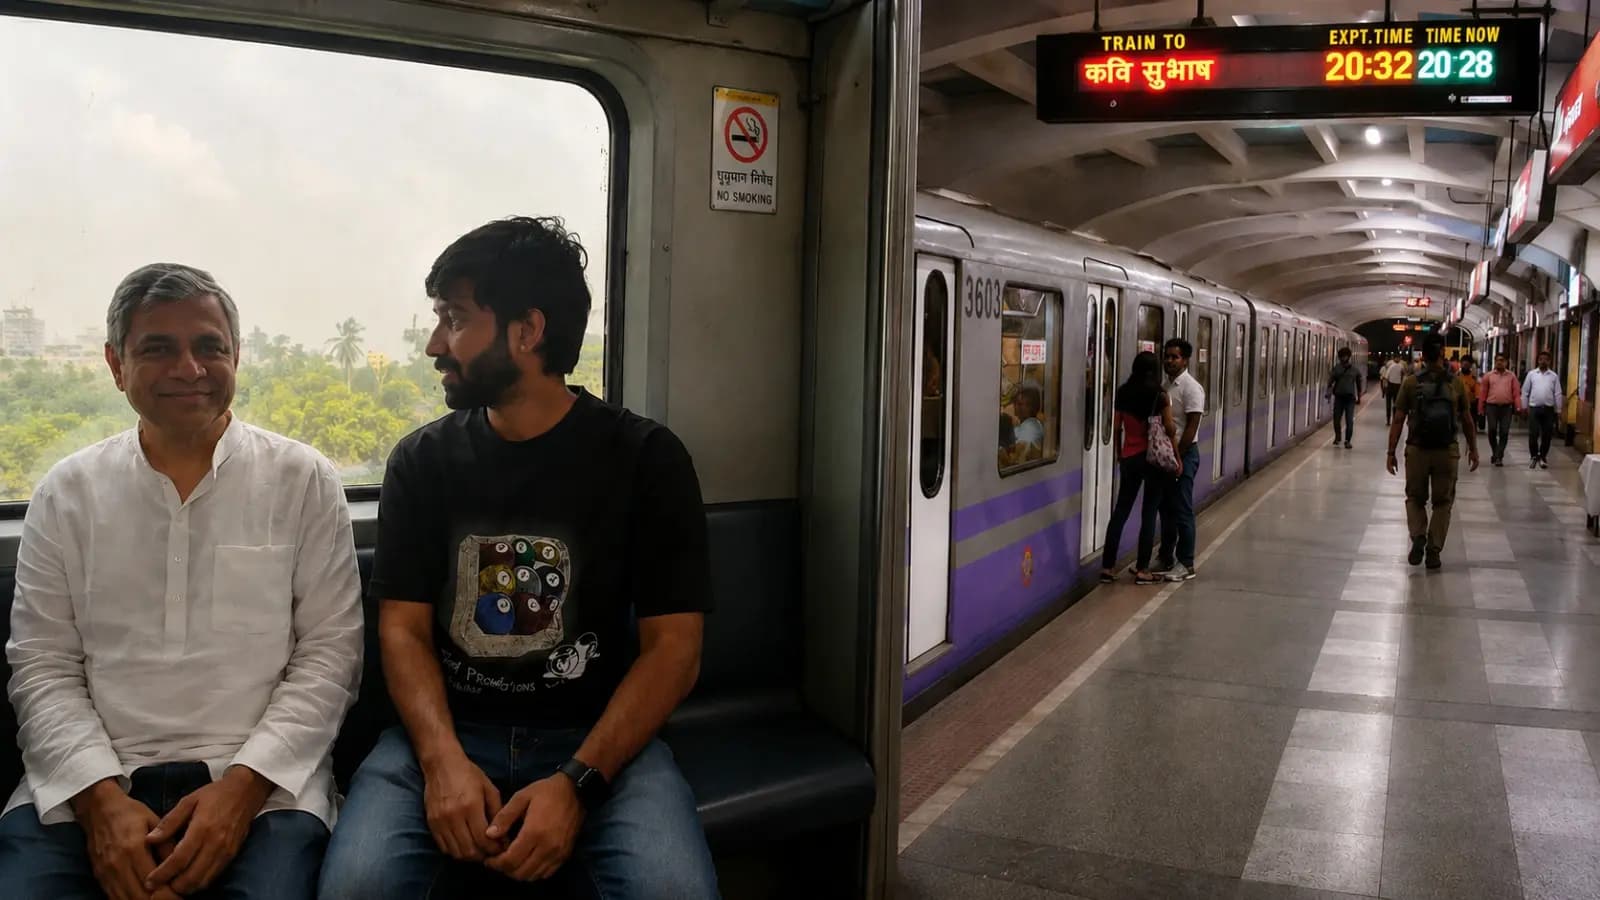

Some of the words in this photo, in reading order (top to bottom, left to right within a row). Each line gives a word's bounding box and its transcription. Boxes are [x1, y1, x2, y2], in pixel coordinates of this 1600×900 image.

[1102, 34, 1155, 51] TRAIN
[1163, 34, 1185, 49] TO
[1425, 27, 1462, 43] TIME
[1466, 26, 1500, 42] NOW
[1084, 56, 1134, 83] कवि
[1142, 57, 1215, 90] सुभाष
[1325, 50, 1413, 81] 20:32
[1418, 49, 1493, 79] 20:28
[717, 190, 729, 201] NO
[733, 191, 772, 205] SMOKING
[965, 275, 1000, 319] 3603
